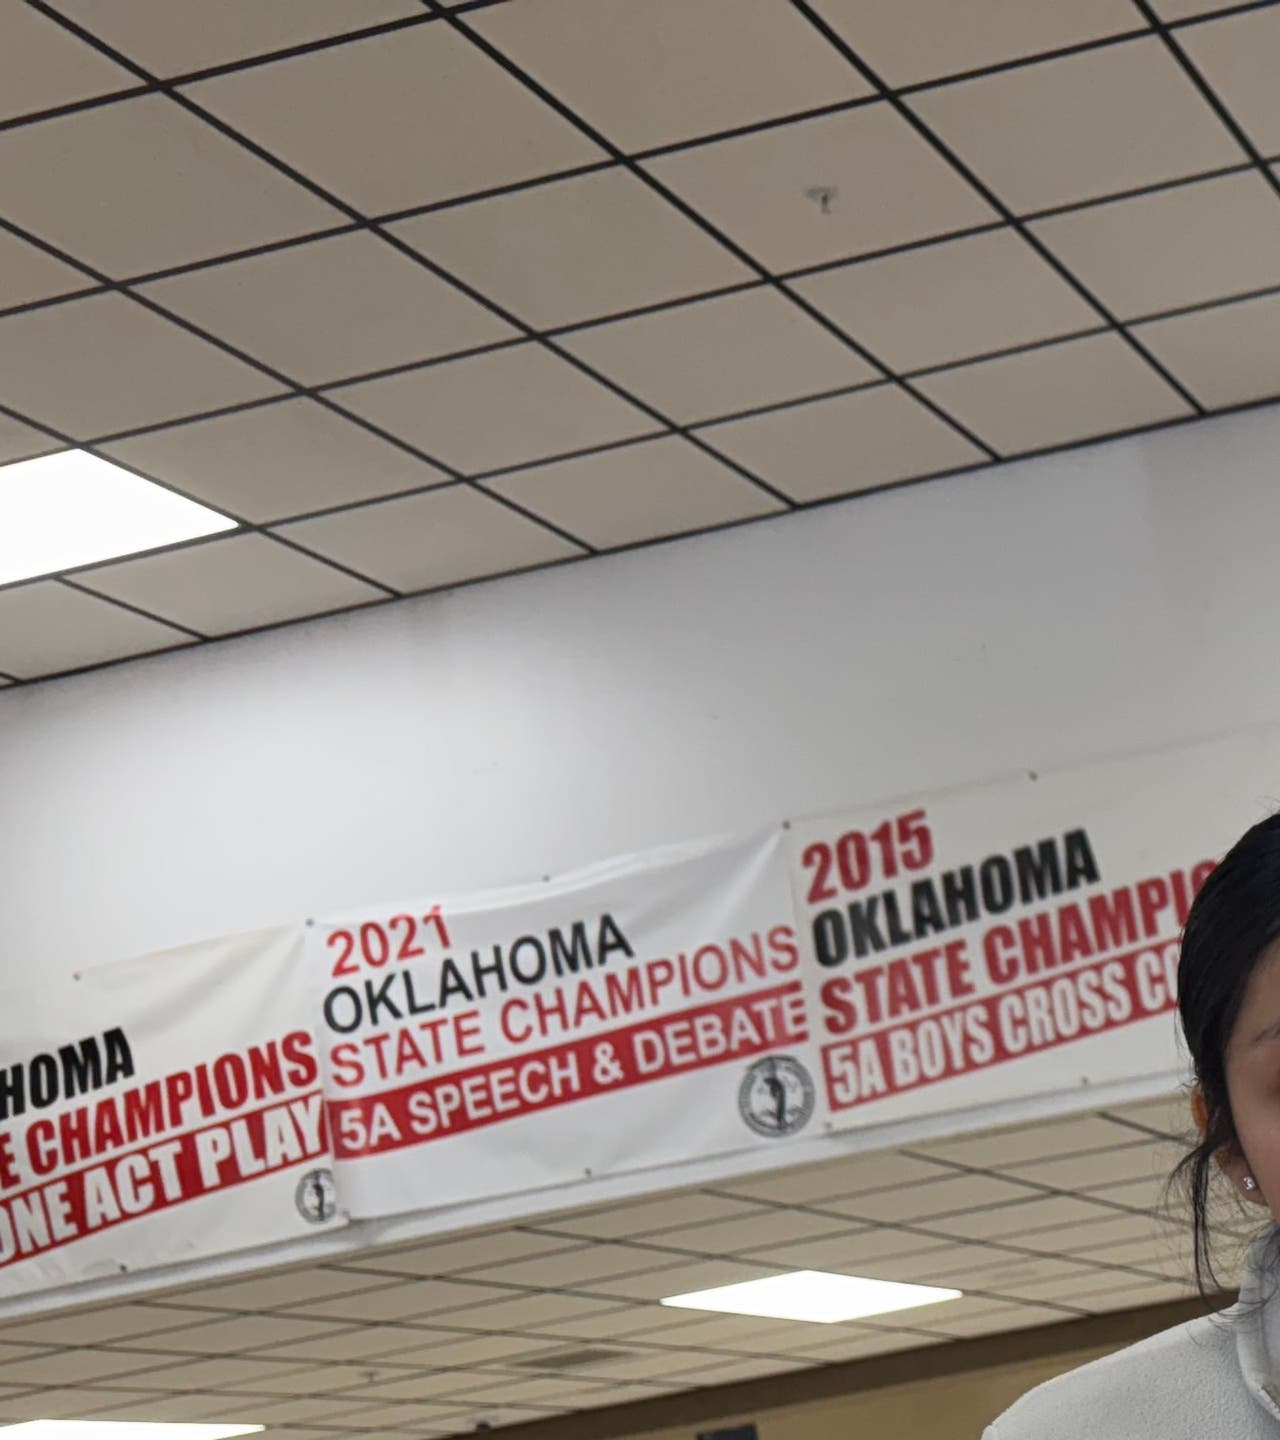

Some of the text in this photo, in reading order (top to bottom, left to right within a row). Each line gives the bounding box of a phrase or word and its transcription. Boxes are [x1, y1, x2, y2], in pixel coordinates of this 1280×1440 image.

[802, 809, 934, 905] 2015
[812, 828, 1101, 968] OKLAHOMA
[323, 913, 636, 1034] OKLAHOMA
[326, 905, 452, 979] 2021
[330, 924, 800, 1087] STATE CHAMPIONS
[820, 938, 976, 1034] STATE
[340, 995, 808, 1149] 5A SPEECH & DEBATE
[829, 1038, 888, 1105] 5A
[888, 1004, 995, 1087] BOYS
[998, 961, 1132, 1053] CROSS
[26, 1030, 318, 1176] CHAMPIONS
[83, 1140, 182, 1230] ACT
[195, 1094, 324, 1188] PLAY
